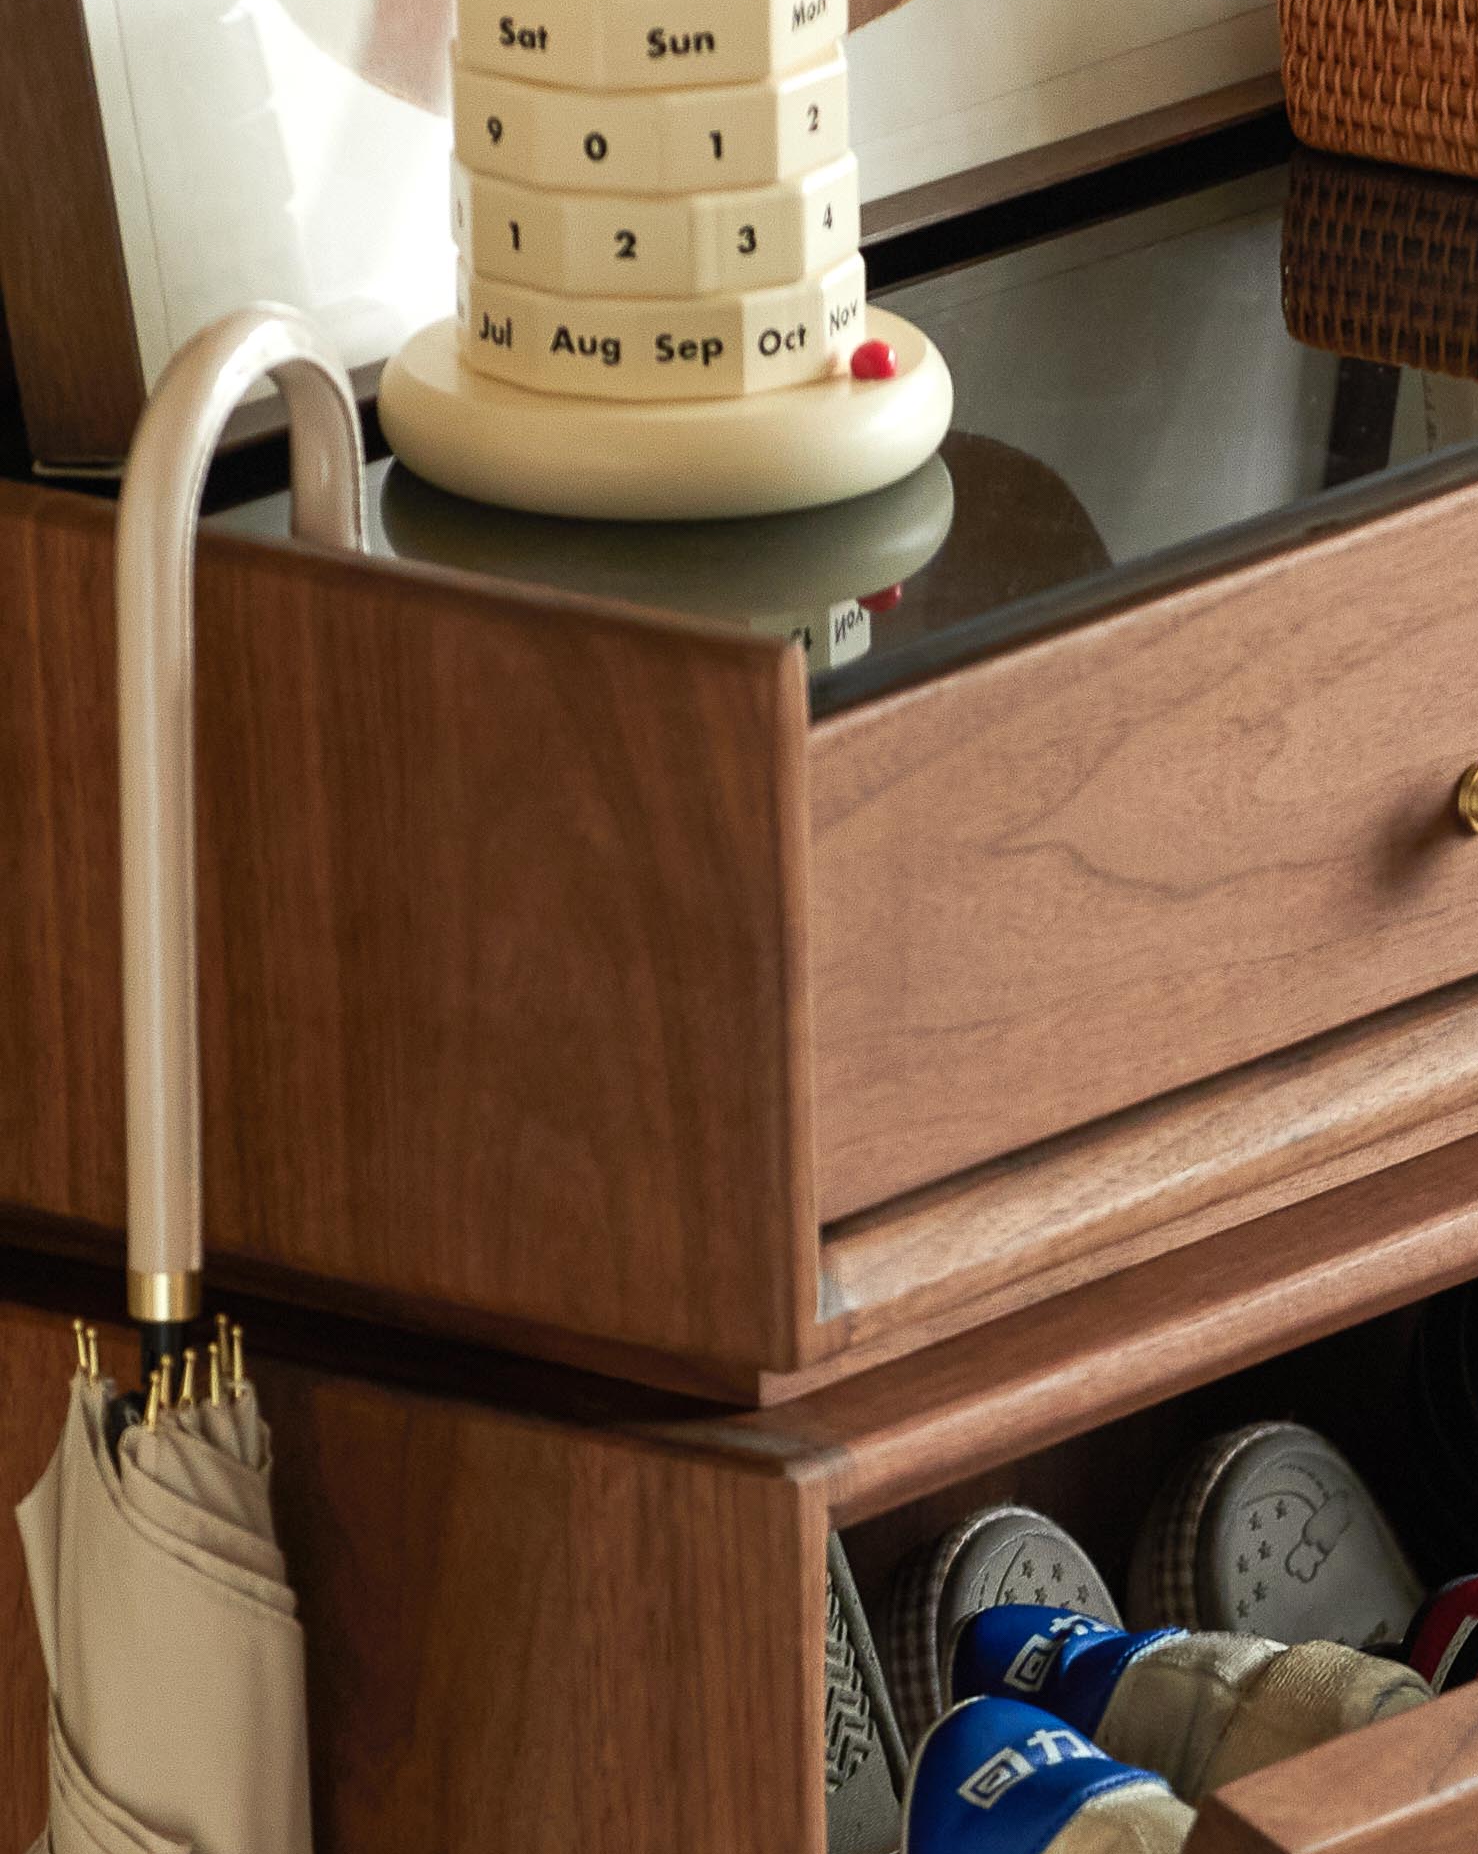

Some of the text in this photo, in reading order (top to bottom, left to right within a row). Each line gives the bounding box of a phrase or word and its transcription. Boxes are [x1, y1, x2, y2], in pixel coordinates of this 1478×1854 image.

[499, 16, 549, 52] Sat
[646, 27, 716, 59] Sun
[486, 104, 820, 162] 9 0 1 2
[508, 203, 834, 261] 1 2 3 4
[479, 312, 514, 350] Jul
[549, 325, 622, 366] Aug
[653, 331, 725, 368] Sep
[757, 322, 808, 358] Oct
[828, 299, 859, 337] Nov
